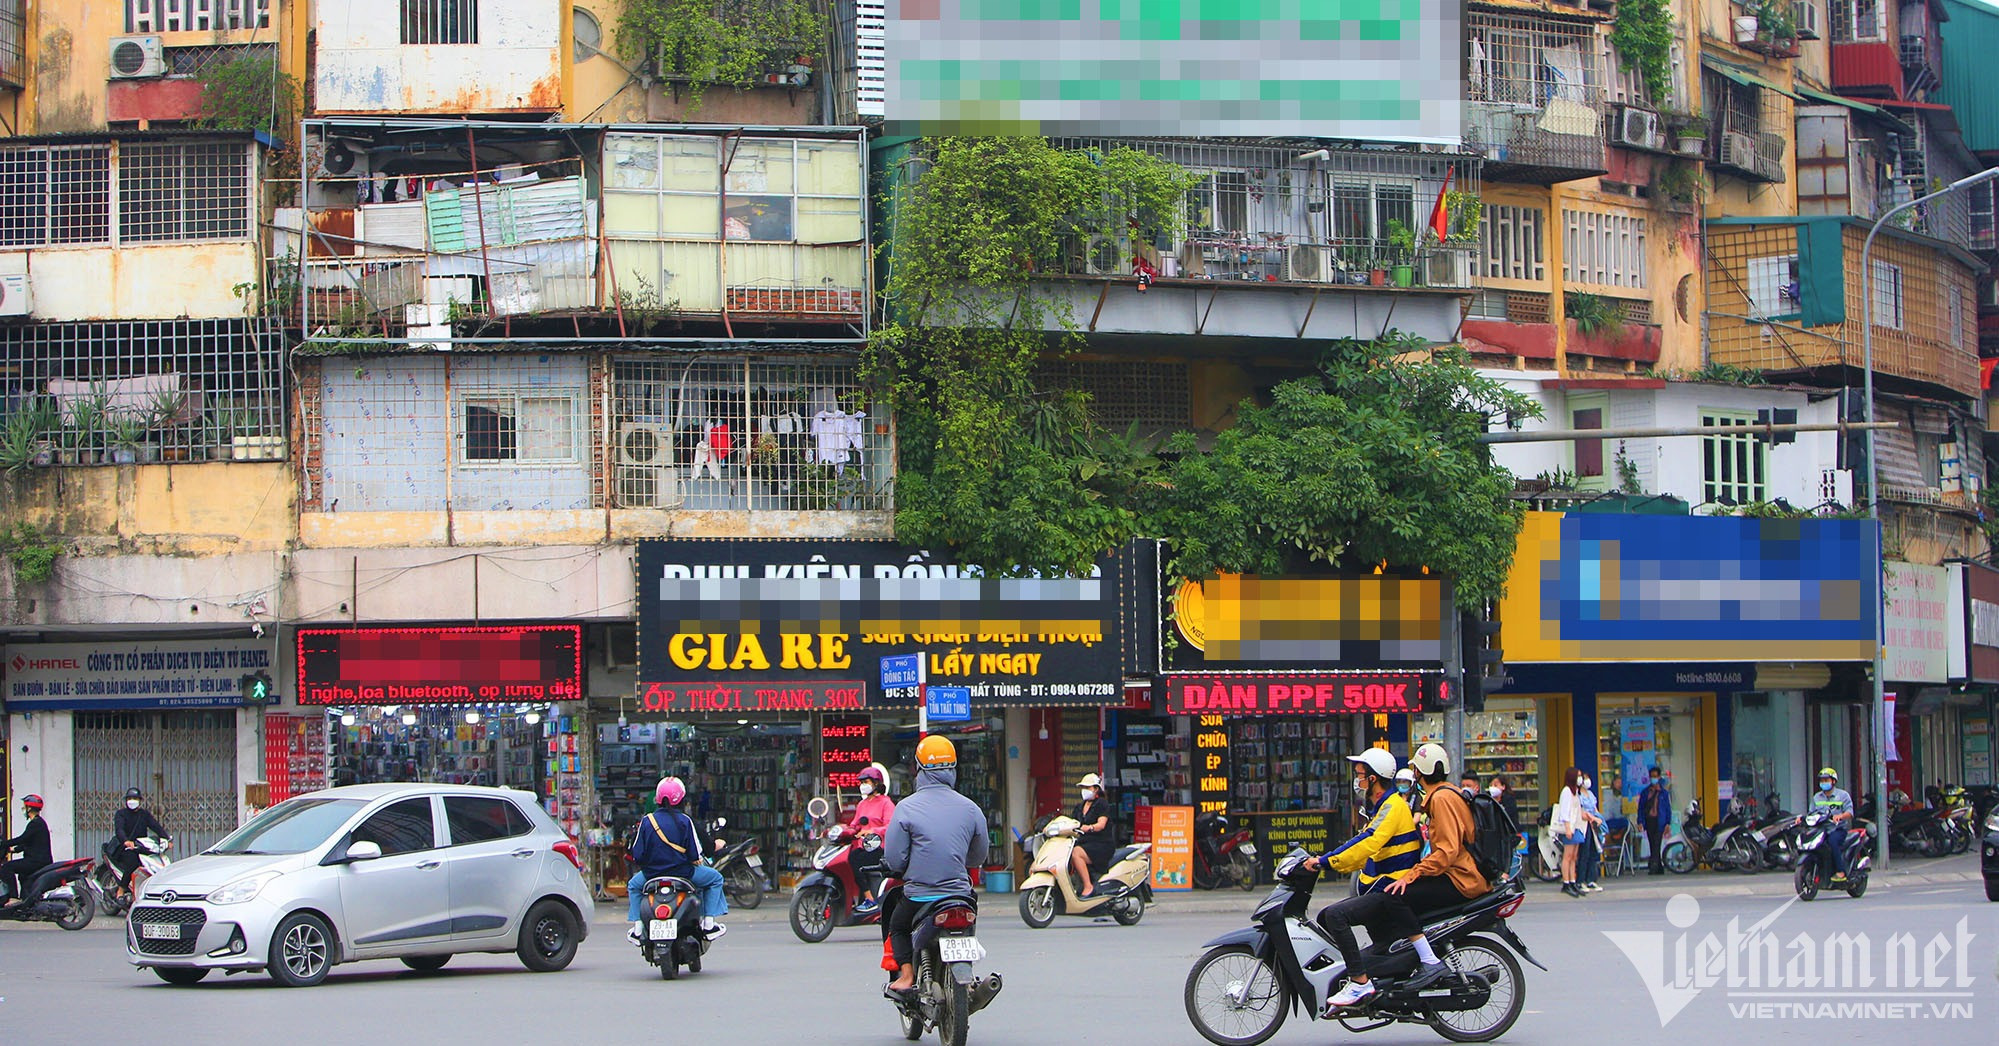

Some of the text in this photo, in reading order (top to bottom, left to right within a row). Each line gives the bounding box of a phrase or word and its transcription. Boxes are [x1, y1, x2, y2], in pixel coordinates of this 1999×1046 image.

[30, 659, 80, 669] HANEL
[88, 650, 111, 671] CÔNG
[114, 653, 124, 670] TY
[167, 652, 189, 674] DỊCH
[191, 652, 202, 673] VỤ
[240, 650, 269, 668] HANEL
[931, 647, 1042, 677] LẤY NGAY
[903, 668, 916, 682] TÁC
[644, 682, 860, 709] ỐP THỜI TRANG 30K
[994, 682, 1021, 697] TÙNG
[1031, 684, 1049, 697] ĐT:
[1051, 684, 1076, 696] 0984
[1078, 683, 1115, 696] 067286
[1268, 684, 1334, 709] PPF
[1343, 683, 1408, 709] 50K
[1197, 730, 1228, 748] CHỮA
[822, 748, 849, 762] CÁC
[1272, 844, 1288, 854] USB
[944, 949, 977, 960] 515.26
